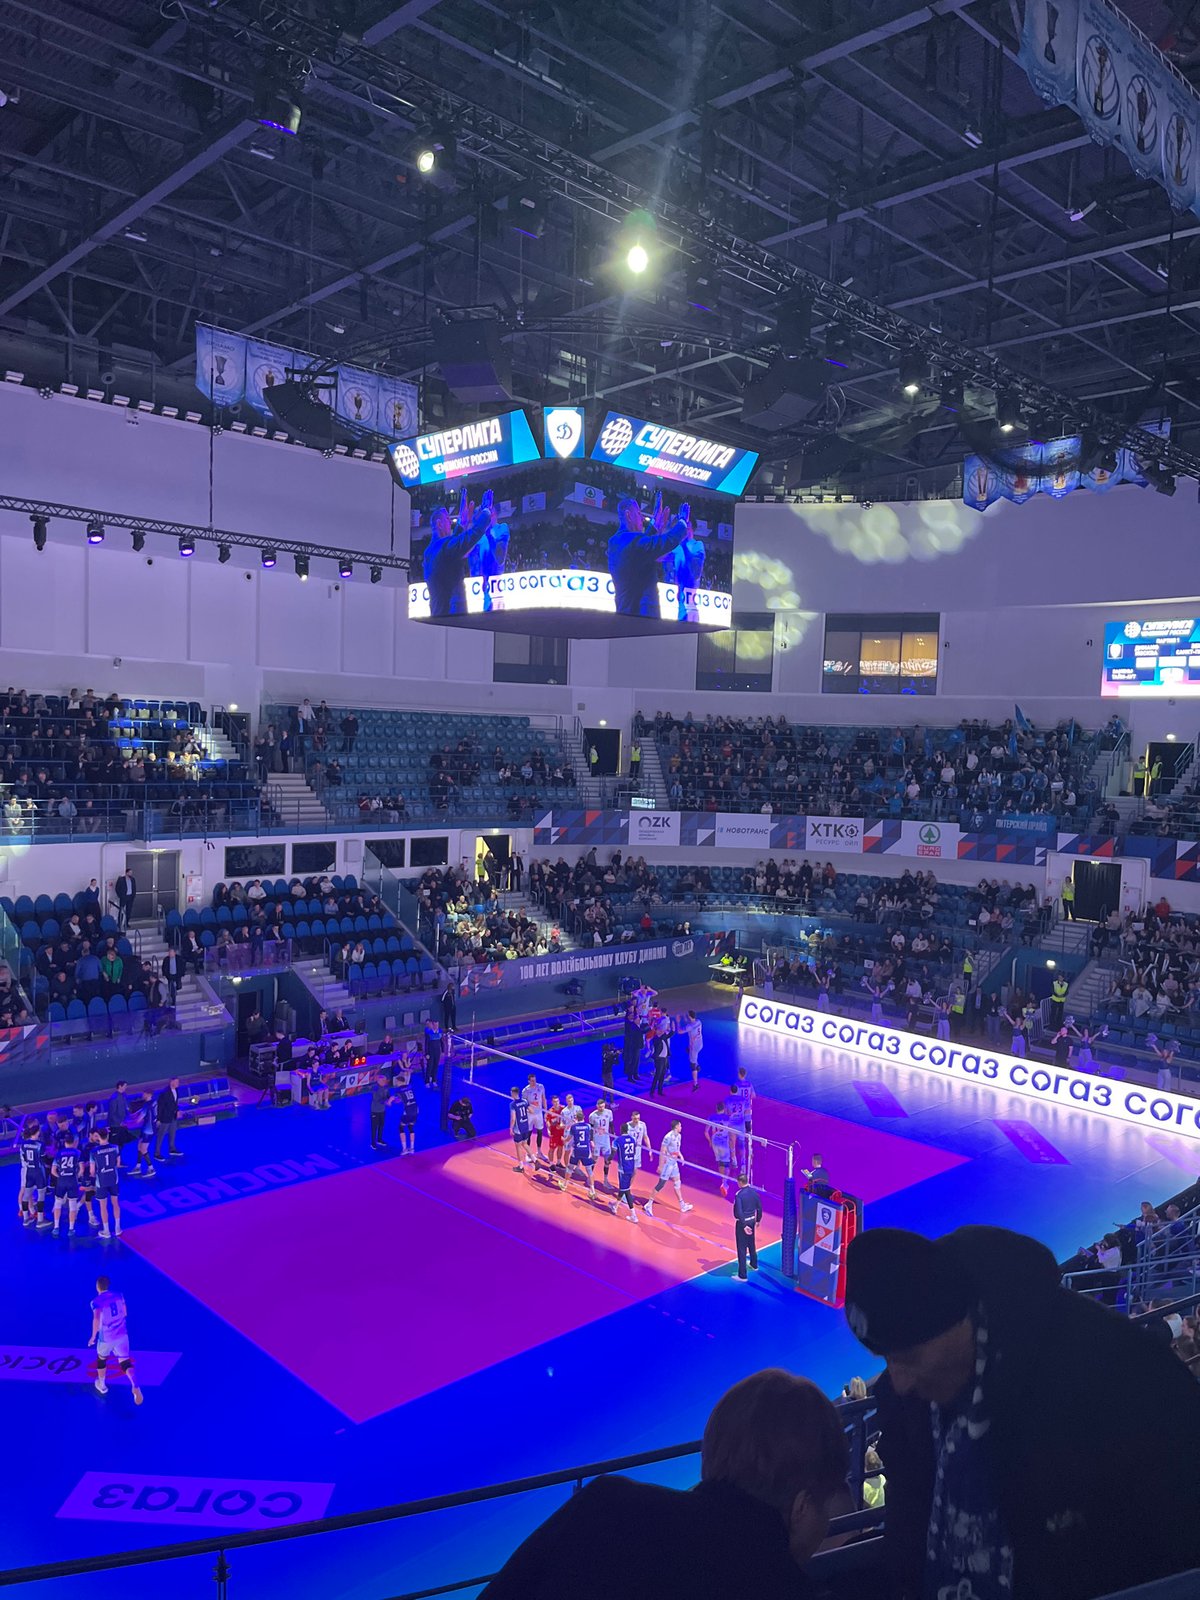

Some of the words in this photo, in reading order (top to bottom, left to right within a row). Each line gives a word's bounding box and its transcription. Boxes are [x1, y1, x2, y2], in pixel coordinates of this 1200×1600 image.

[416, 418, 502, 460] СУПЕРЛИГА
[635, 425, 736, 469] СУПЕРЛИГА
[433, 456, 471, 474] ЧЕМПИОНАТ
[471, 450, 498, 467] РОССИИ
[638, 453, 682, 474] ЧЕМПИОНАТ
[680, 464, 712, 482] РОССИИ
[725, 827, 770, 836] НОВОТРАНС
[520, 964, 534, 980] 100
[535, 964, 549, 978] ЛЕТ
[551, 953, 613, 976] ВОЛЕЙБОЛЬНОМУ
[614, 950, 638, 966] КЛУБУ
[639, 946, 667, 964] ДИНАМО
[520, 1107, 527, 1117] 11
[732, 1103, 743, 1113] 23
[579, 1131, 585, 1141] 3
[624, 1143, 634, 1154] 23
[61, 1156, 74, 1169] 24
[104, 1154, 109, 1166] 1
[120, 1153, 341, 1219] МОСКВА
[110, 1301, 119, 1317] 8
